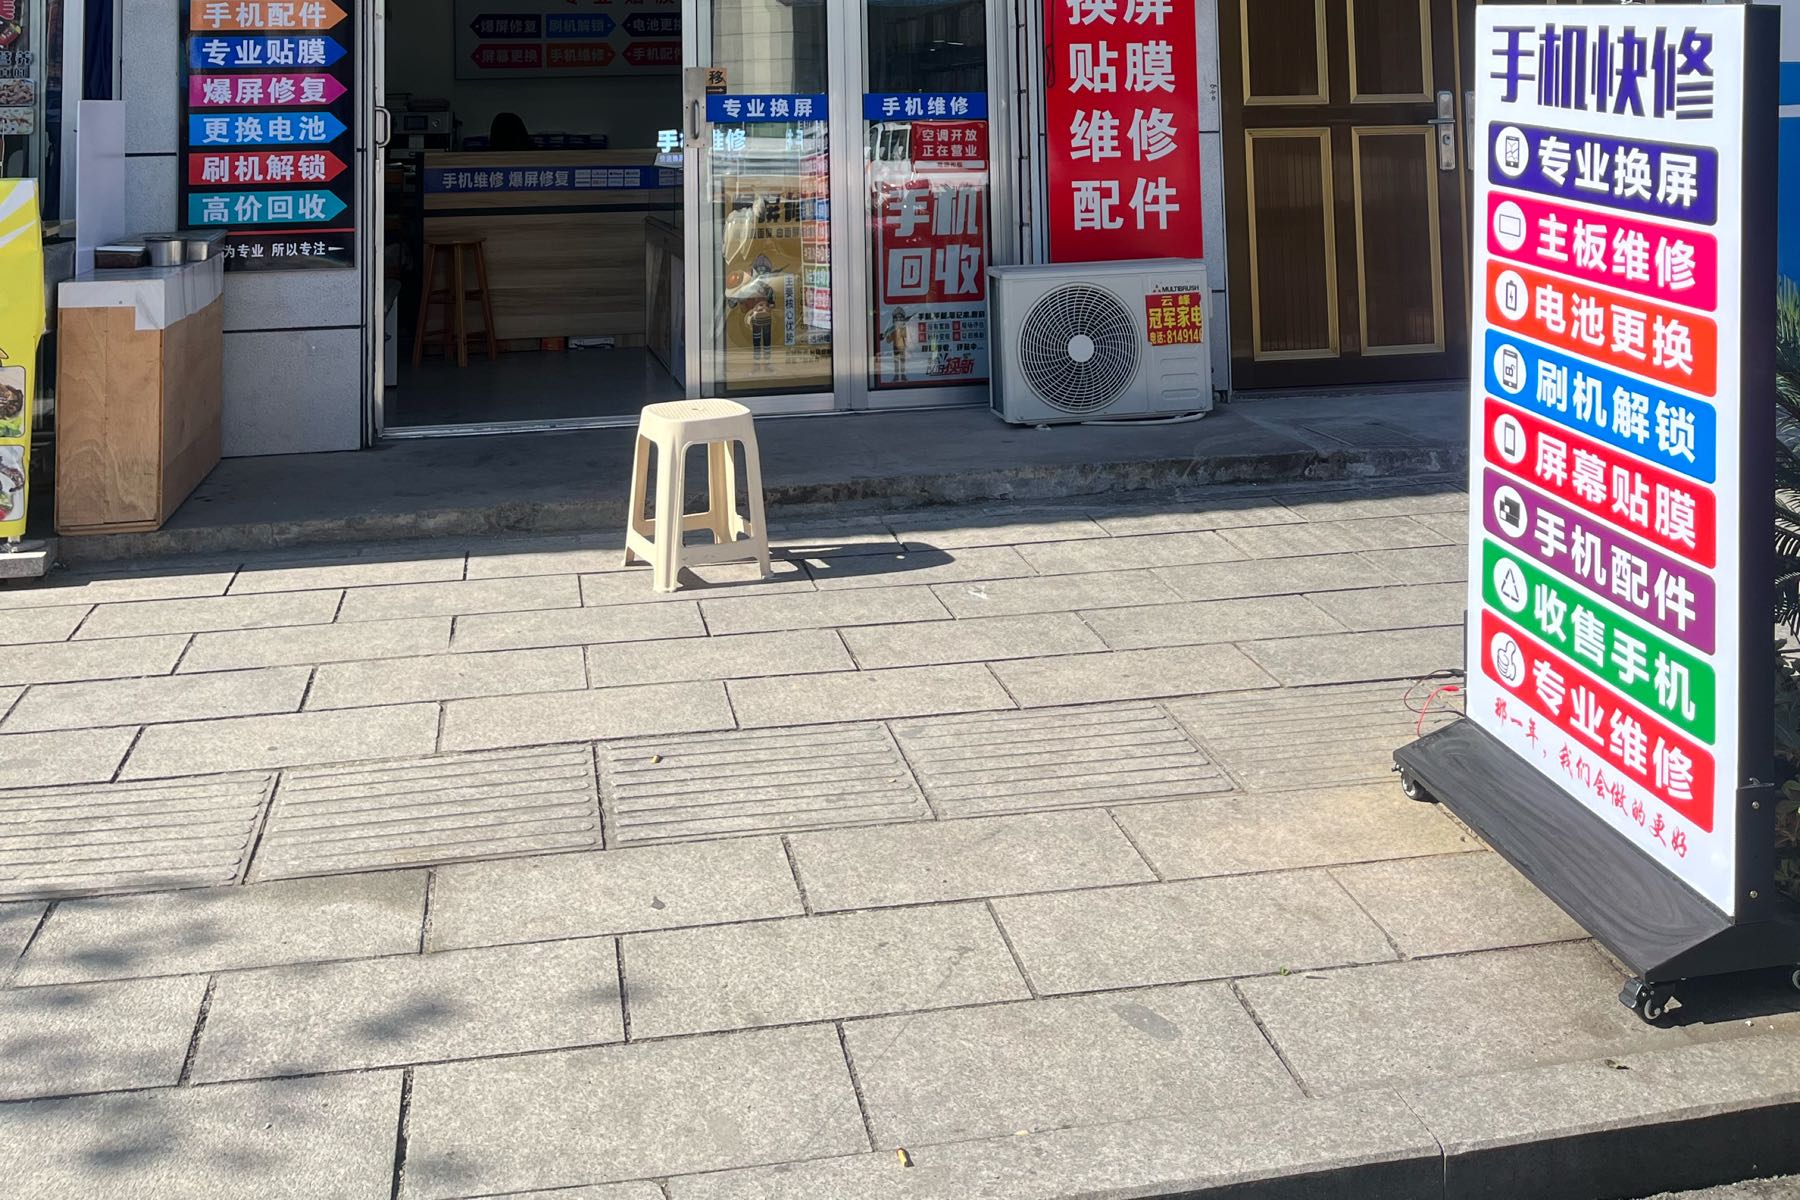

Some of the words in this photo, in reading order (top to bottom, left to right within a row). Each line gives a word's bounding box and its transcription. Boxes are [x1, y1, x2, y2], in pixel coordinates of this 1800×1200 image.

[202, 1, 327, 29] 手机配件
[202, 38, 326, 66] 专业贴膜
[1068, 40, 1176, 93] 贴膜
[1490, 22, 1714, 120] 手机快修
[203, 76, 327, 105] 爆屏修复
[708, 70, 726, 85] 移
[723, 98, 813, 119] 专业换屏
[882, 97, 969, 116] 手机维修
[202, 115, 326, 144] 更换电池
[921, 128, 977, 142] 空调开放
[1070, 107, 1178, 163] 维修
[202, 154, 326, 182] 刷机解锁
[921, 144, 977, 157] 正在营业
[442, 171, 504, 189] 手机维修
[508, 170, 569, 187] 爆屏修复
[1537, 136, 1699, 208] 专业换屏
[202, 193, 326, 223] 高价回收
[1071, 177, 1180, 231] 配件
[887, 244, 981, 297] 回收
[1536, 212, 1697, 291] 主板维修
[1149, 306, 1202, 328] 冠军家电
[1535, 284, 1695, 376] 电池更换
[1536, 358, 1696, 464] 刷机解锁
[1535, 432, 1697, 551] 屏幕贴膜
[1534, 509, 1697, 633] 手机配件
[1534, 583, 1697, 723] 收售手机
[1533, 657, 1694, 801] 专业维修
